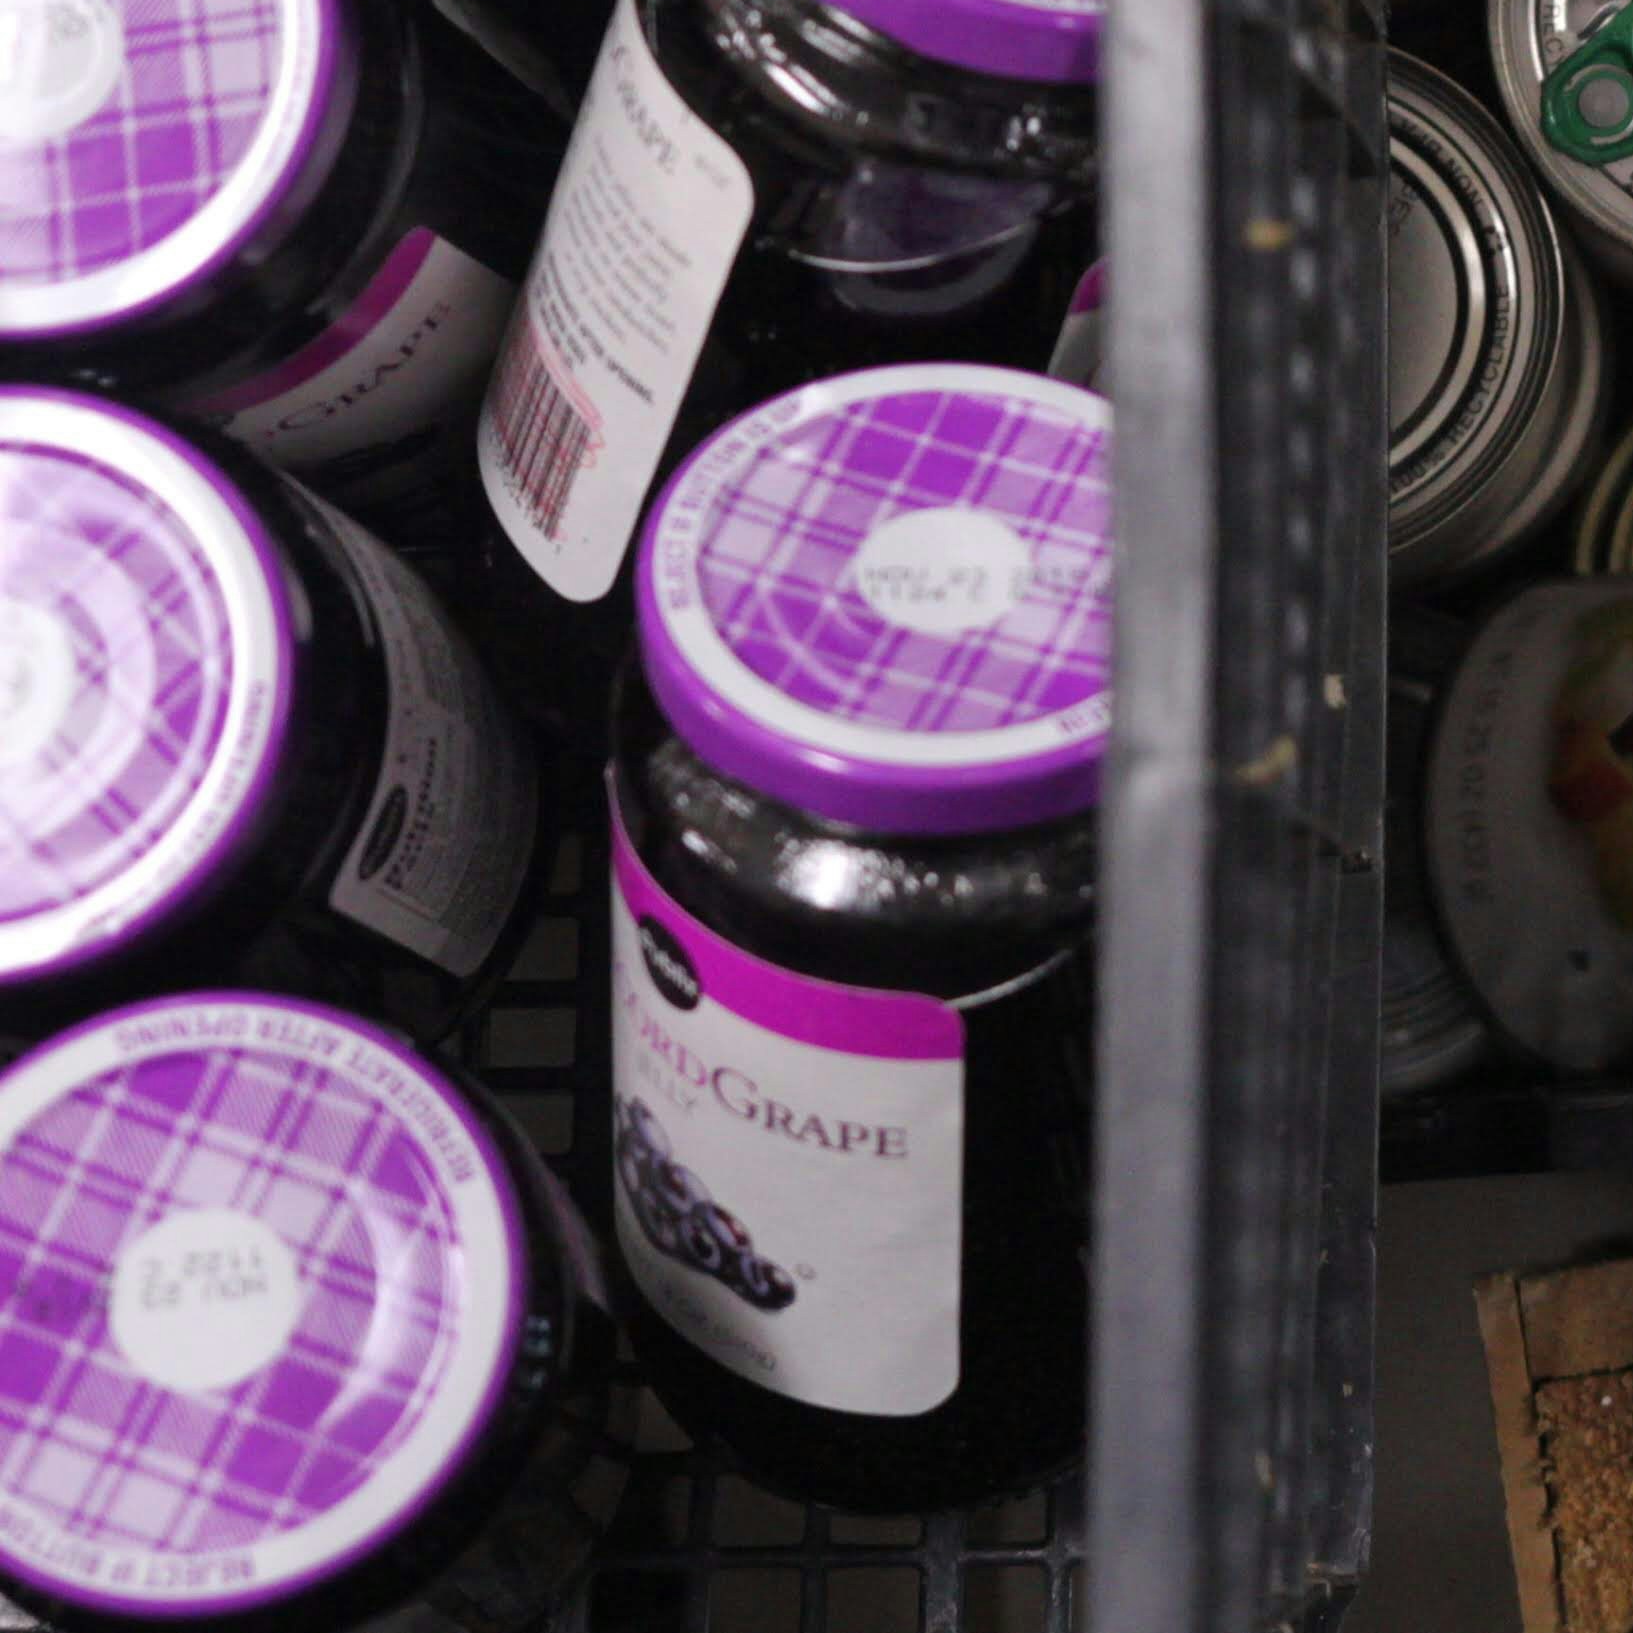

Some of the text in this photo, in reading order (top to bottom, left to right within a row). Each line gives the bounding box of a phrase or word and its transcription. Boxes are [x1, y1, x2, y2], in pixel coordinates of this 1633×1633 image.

[1445, 285, 1511, 450] RECYCLABLE
[257, 1016, 338, 1055] AFTER
[710, 1065, 911, 1163] GRAPE
[144, 1554, 256, 1589] REJECT
